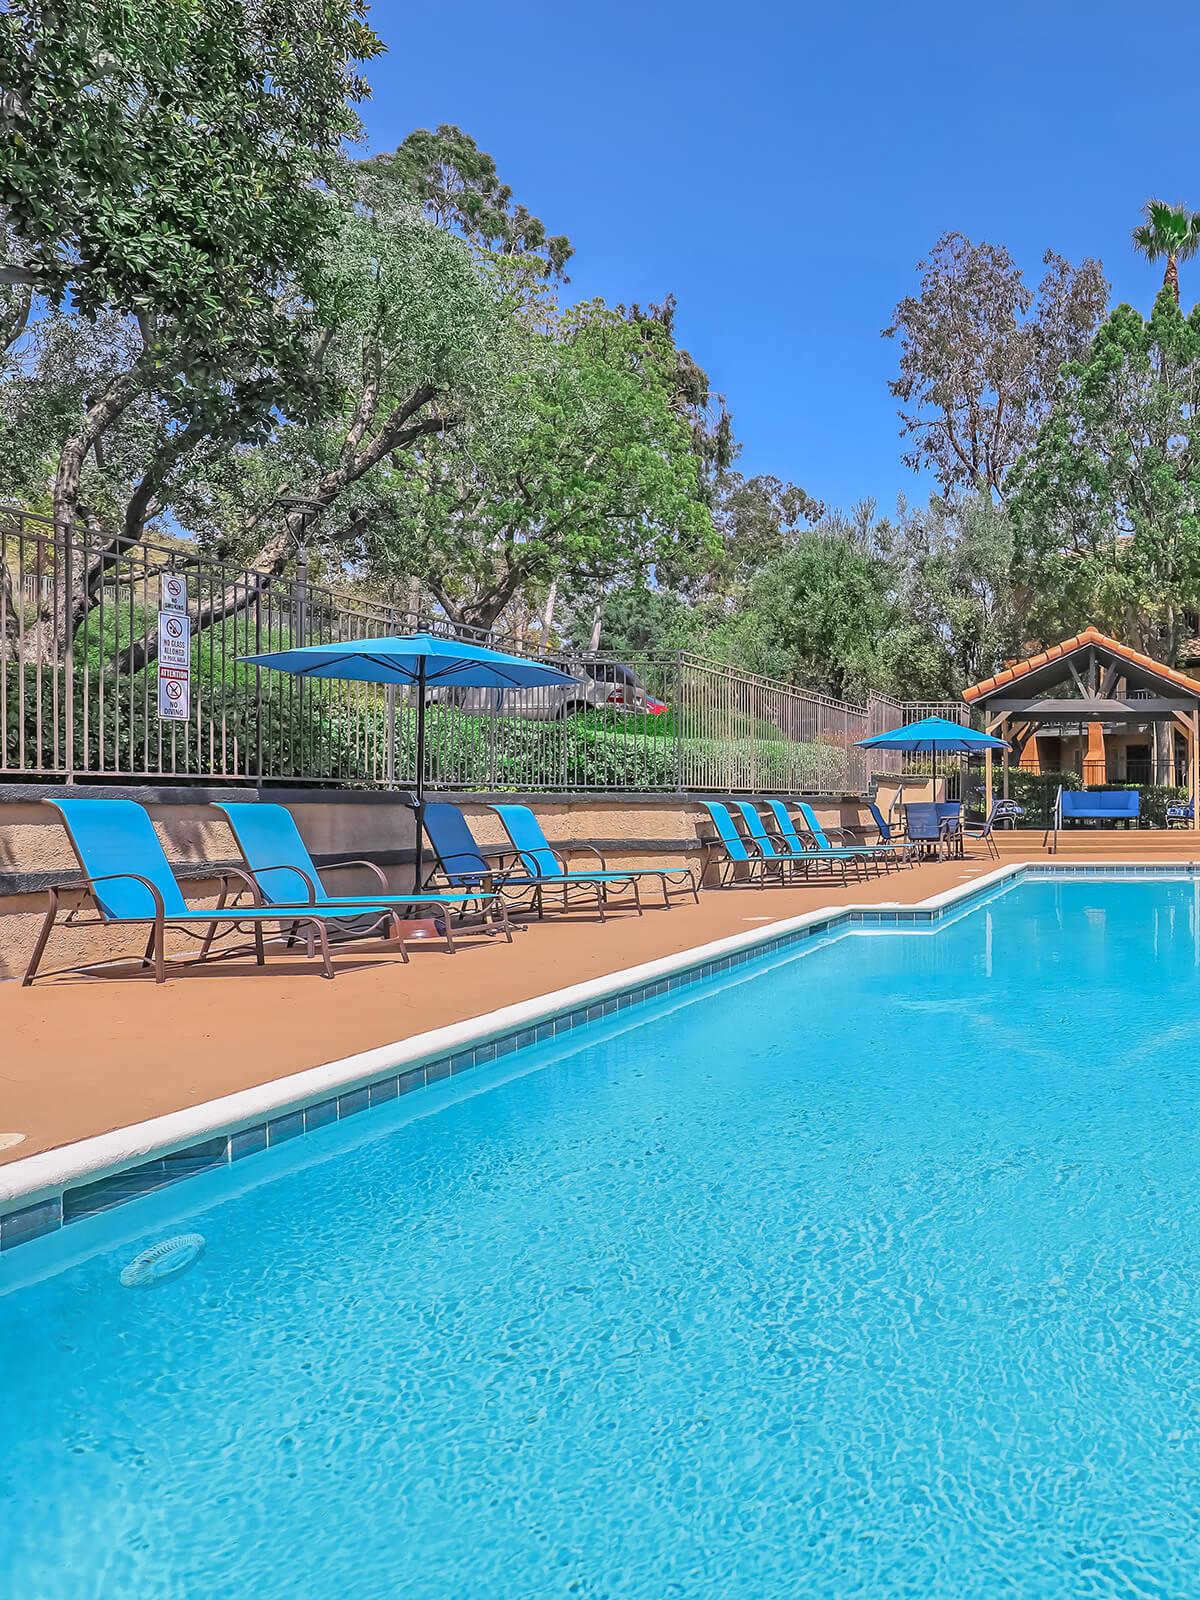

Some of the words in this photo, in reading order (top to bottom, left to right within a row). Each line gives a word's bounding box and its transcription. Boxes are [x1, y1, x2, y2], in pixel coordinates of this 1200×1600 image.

[164, 602, 184, 611] SMOKING
[171, 640, 185, 648] GLASS
[164, 647, 184, 656] ALLOWED
[161, 669, 187, 679] ATTENTION
[164, 708, 183, 716] DIVING
